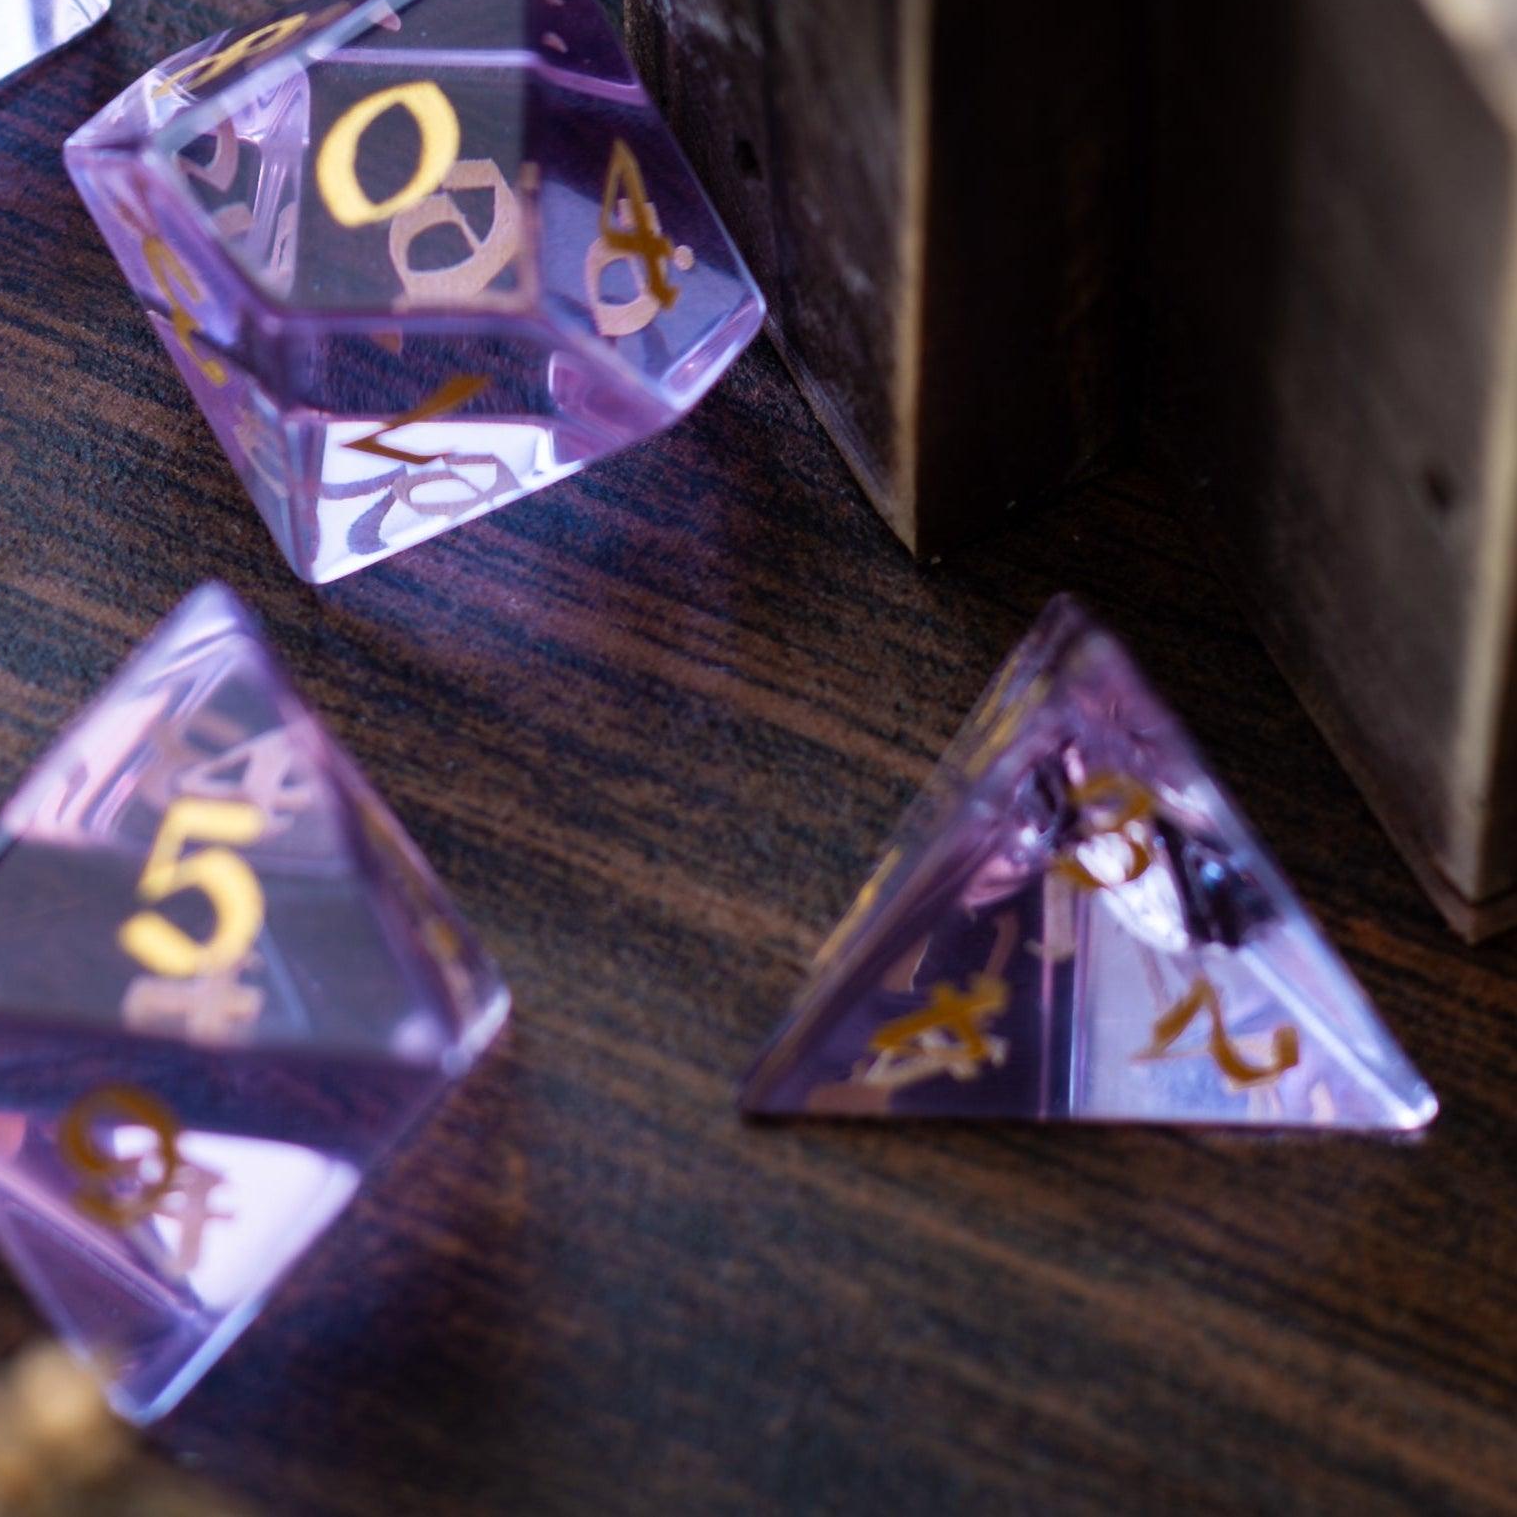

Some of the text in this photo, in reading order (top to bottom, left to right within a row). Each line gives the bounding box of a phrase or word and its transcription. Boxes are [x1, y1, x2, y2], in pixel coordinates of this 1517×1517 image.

[316, 80, 461, 229] 0
[599, 138, 680, 312] 4
[117, 796, 267, 979] 5
